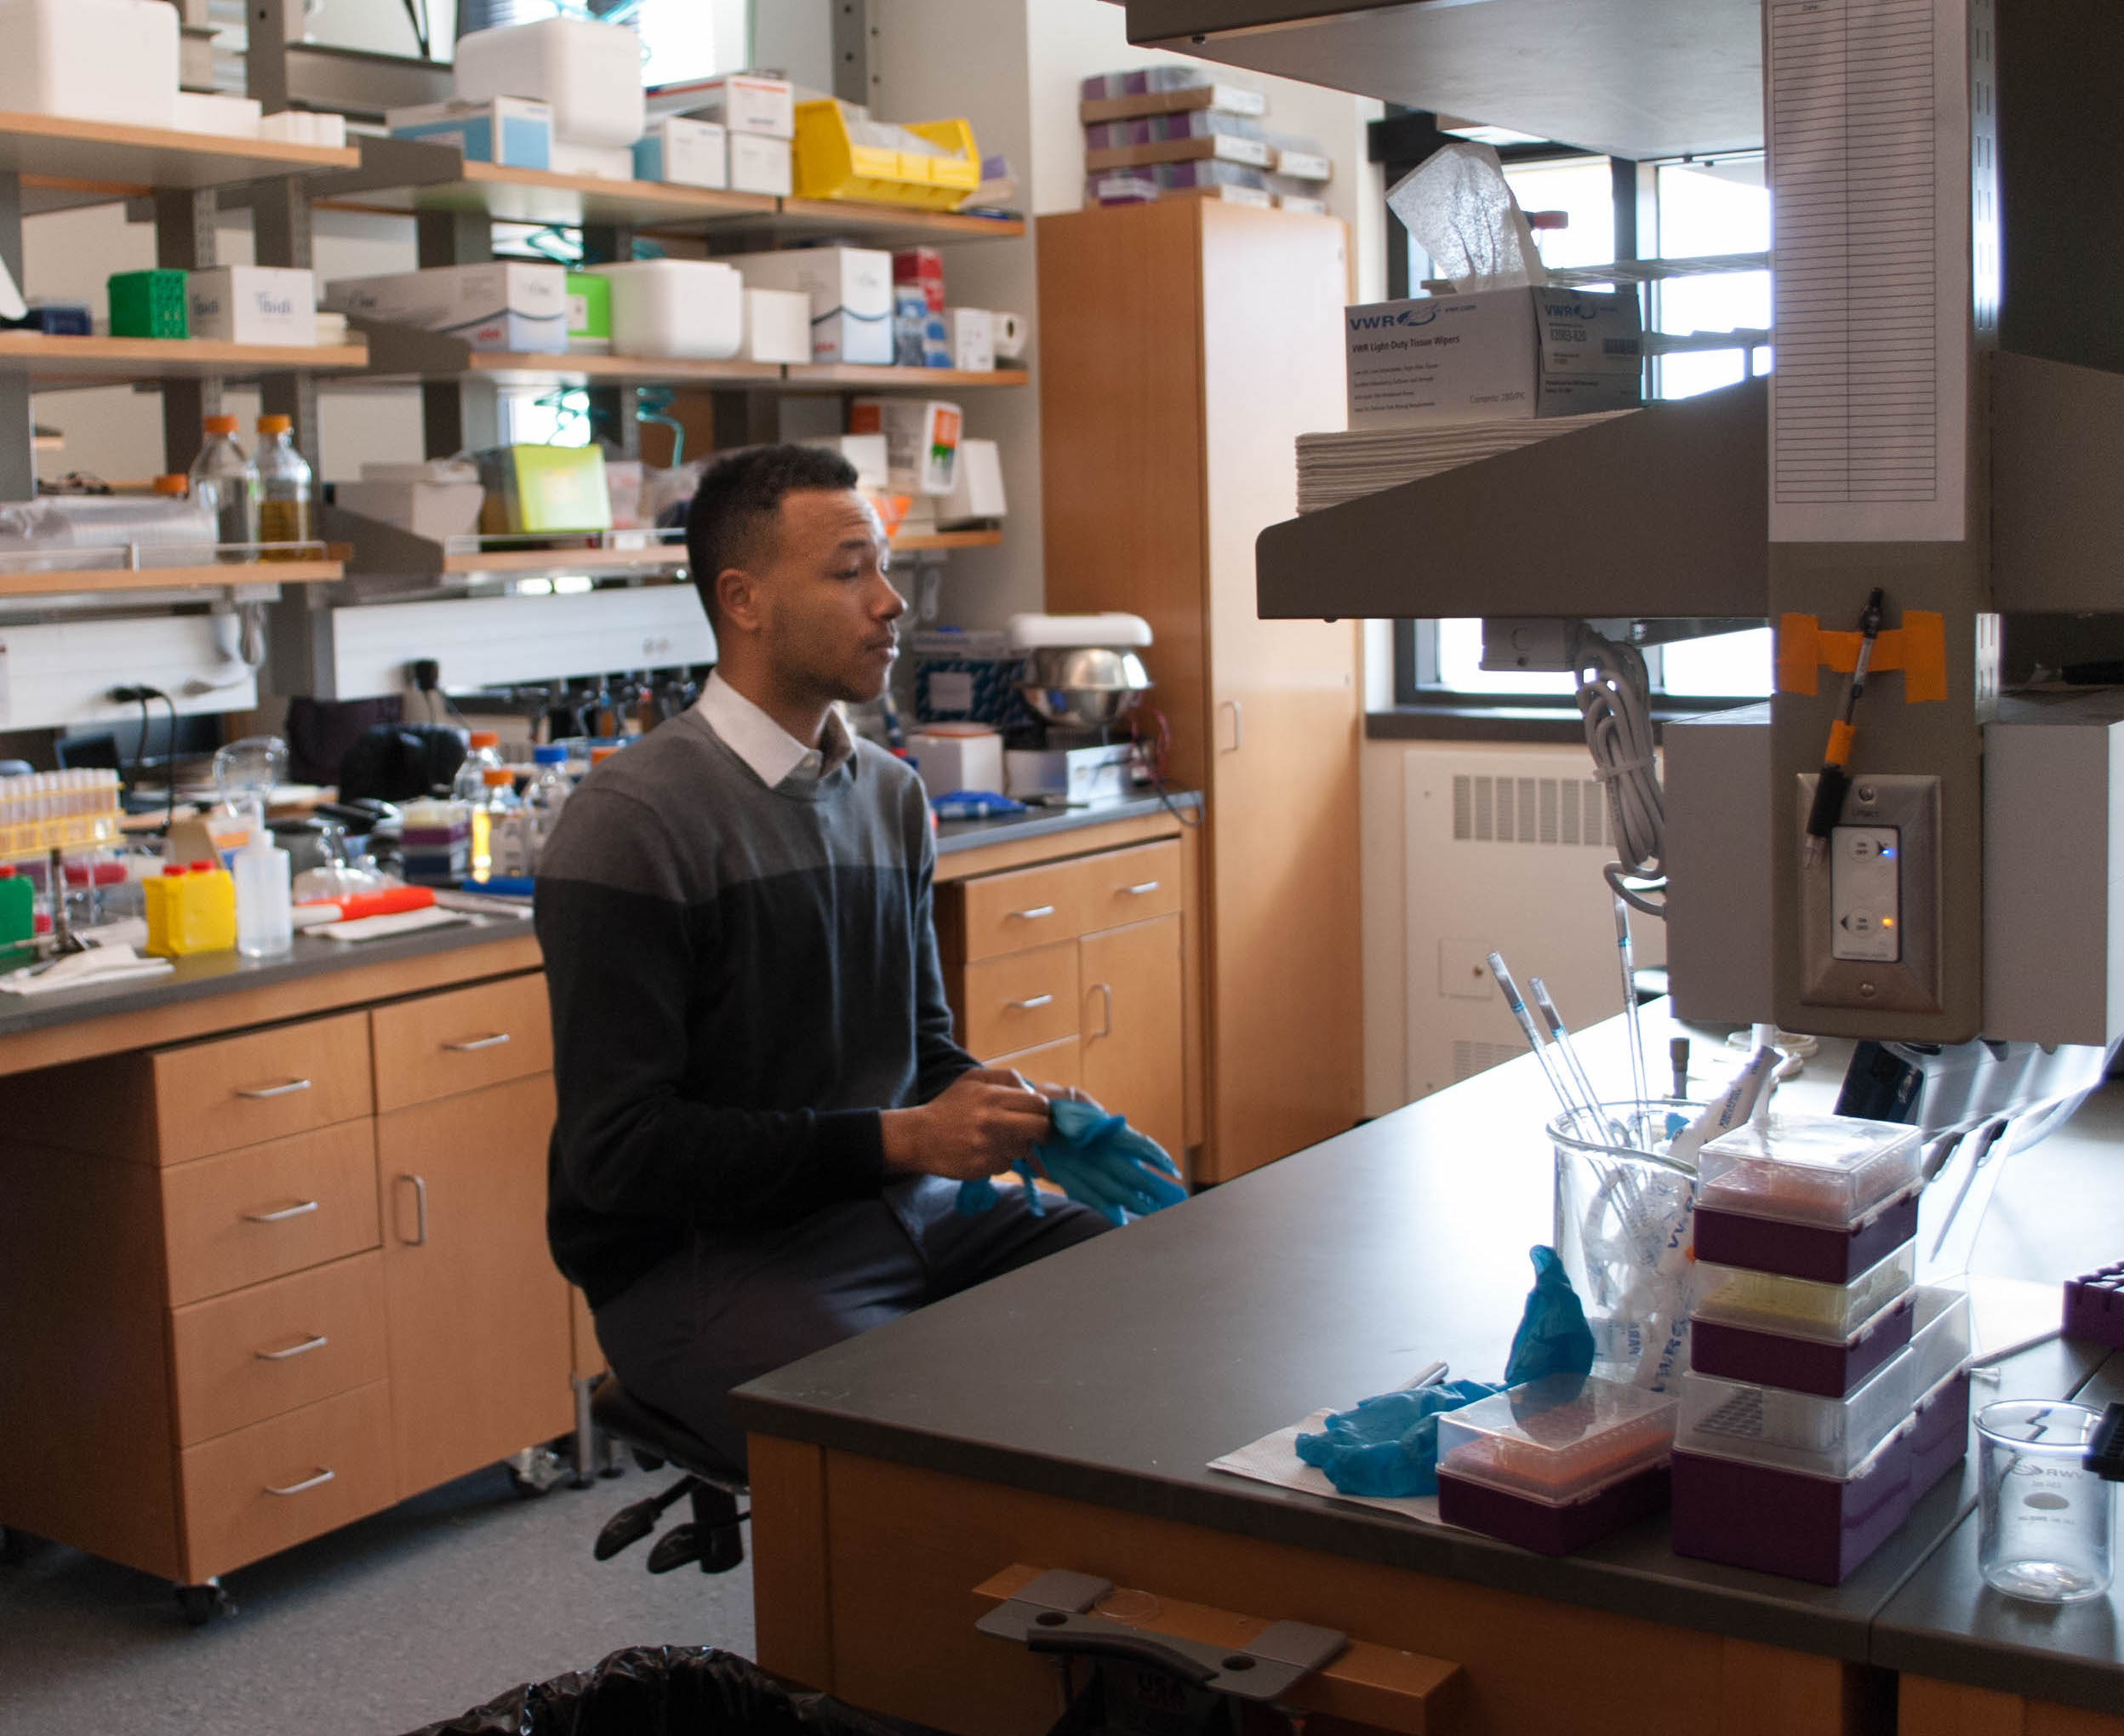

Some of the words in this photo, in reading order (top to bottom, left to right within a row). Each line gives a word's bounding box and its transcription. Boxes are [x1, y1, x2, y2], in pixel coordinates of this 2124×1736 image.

[1544, 305, 1573, 317] VWR
[1350, 314, 1396, 331] VWR
[1371, 340, 1408, 353] Light-Duty
[1410, 338, 1433, 348] Tissue
[1434, 335, 1461, 348] Wipers
